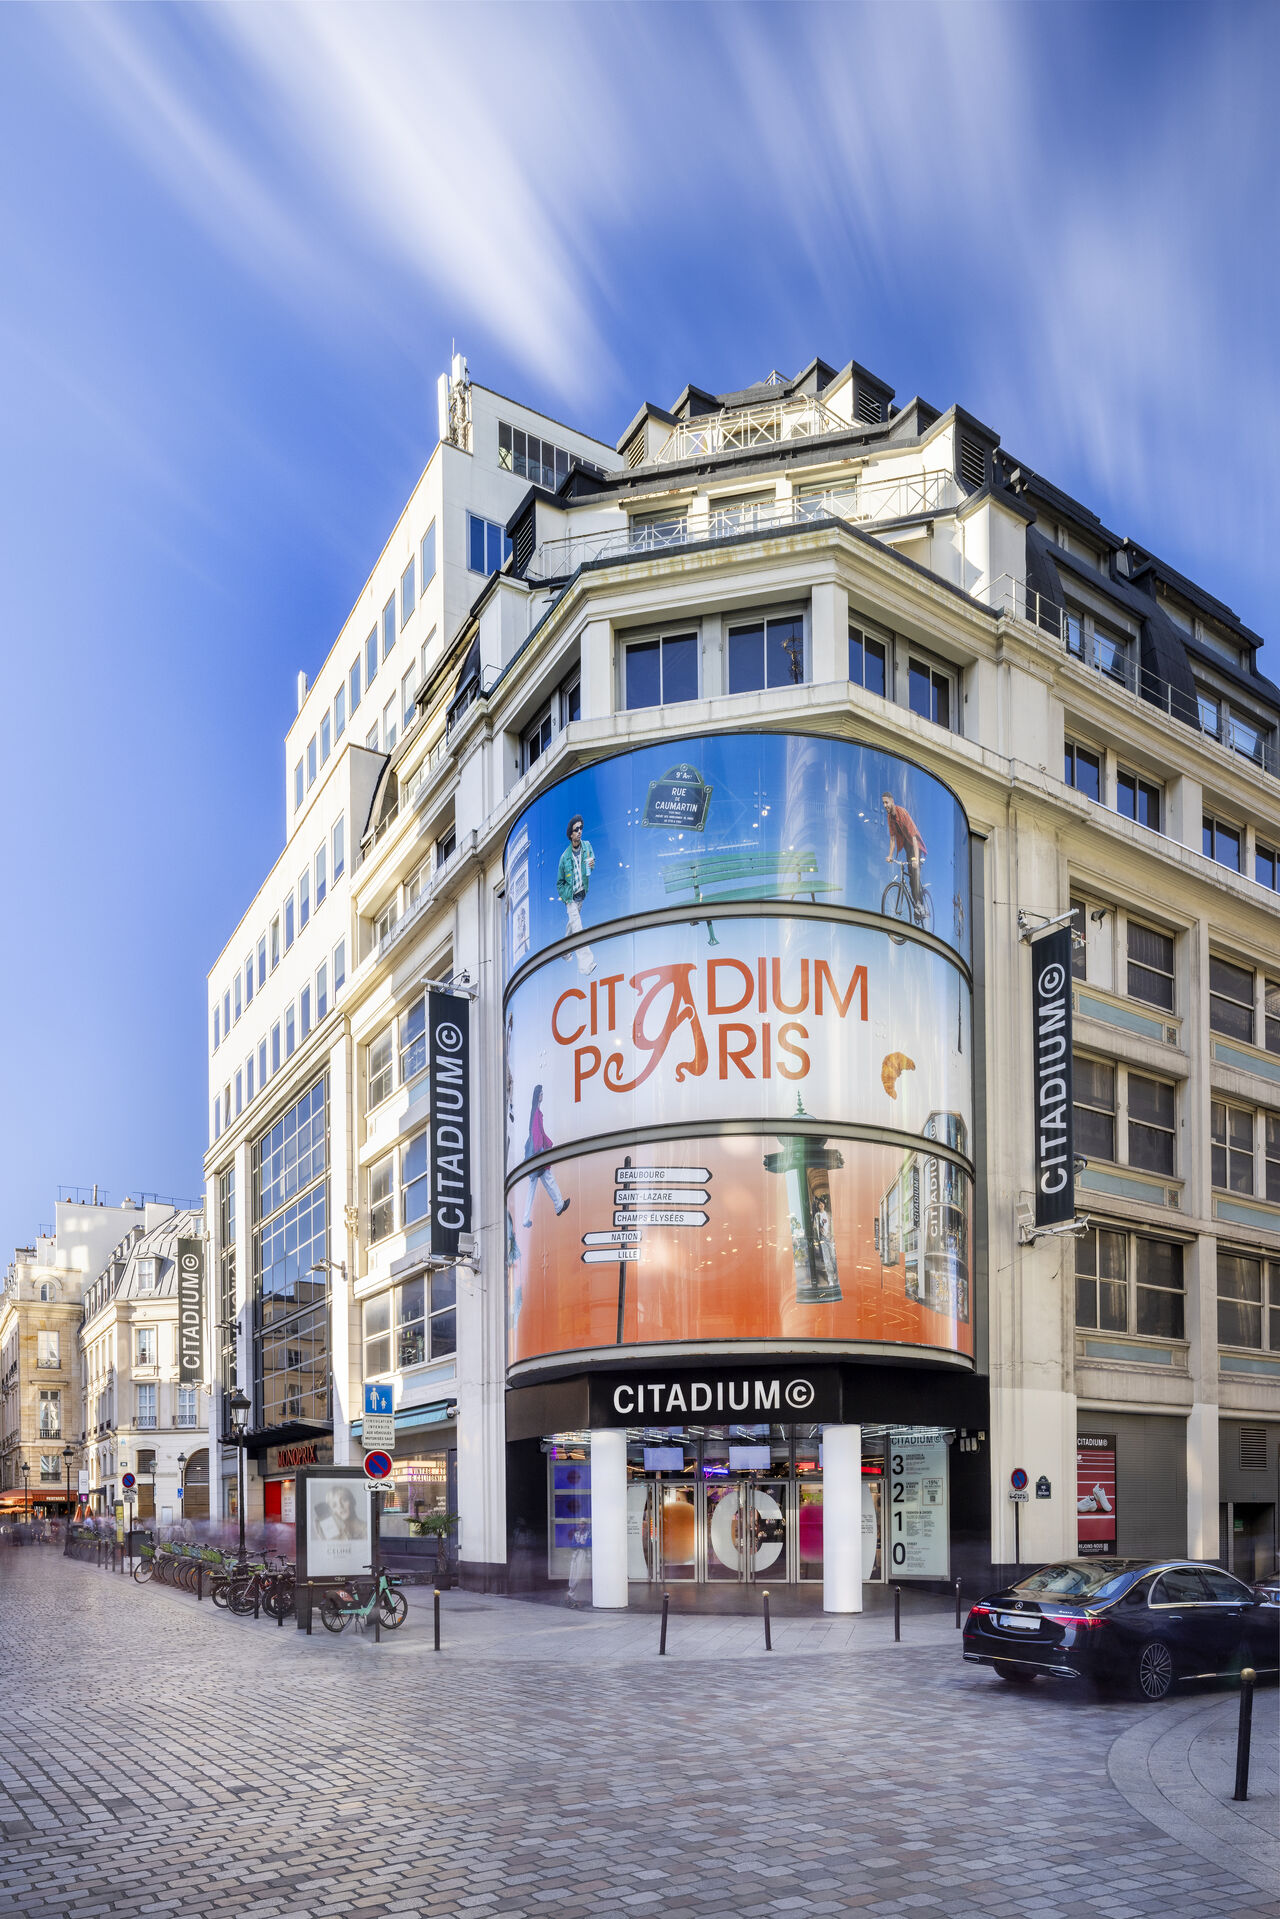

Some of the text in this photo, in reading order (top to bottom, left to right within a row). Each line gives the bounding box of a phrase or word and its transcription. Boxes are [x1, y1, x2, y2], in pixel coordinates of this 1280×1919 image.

[671, 787, 687, 796] RUE
[655, 801, 698, 812] CAUMARTIN
[619, 1170, 666, 1179] BEAUBOURG
[618, 1192, 673, 1201] SAINT-LAZARE
[611, 1232, 638, 1241] NATION
[618, 1250, 638, 1258] LILLE
[278, 1445, 317, 1468] MONOPRIX
[892, 1454, 904, 1476] 3
[893, 1482, 904, 1503] 2
[894, 1511, 902, 1532] 1
[892, 1542, 906, 1566] 0
